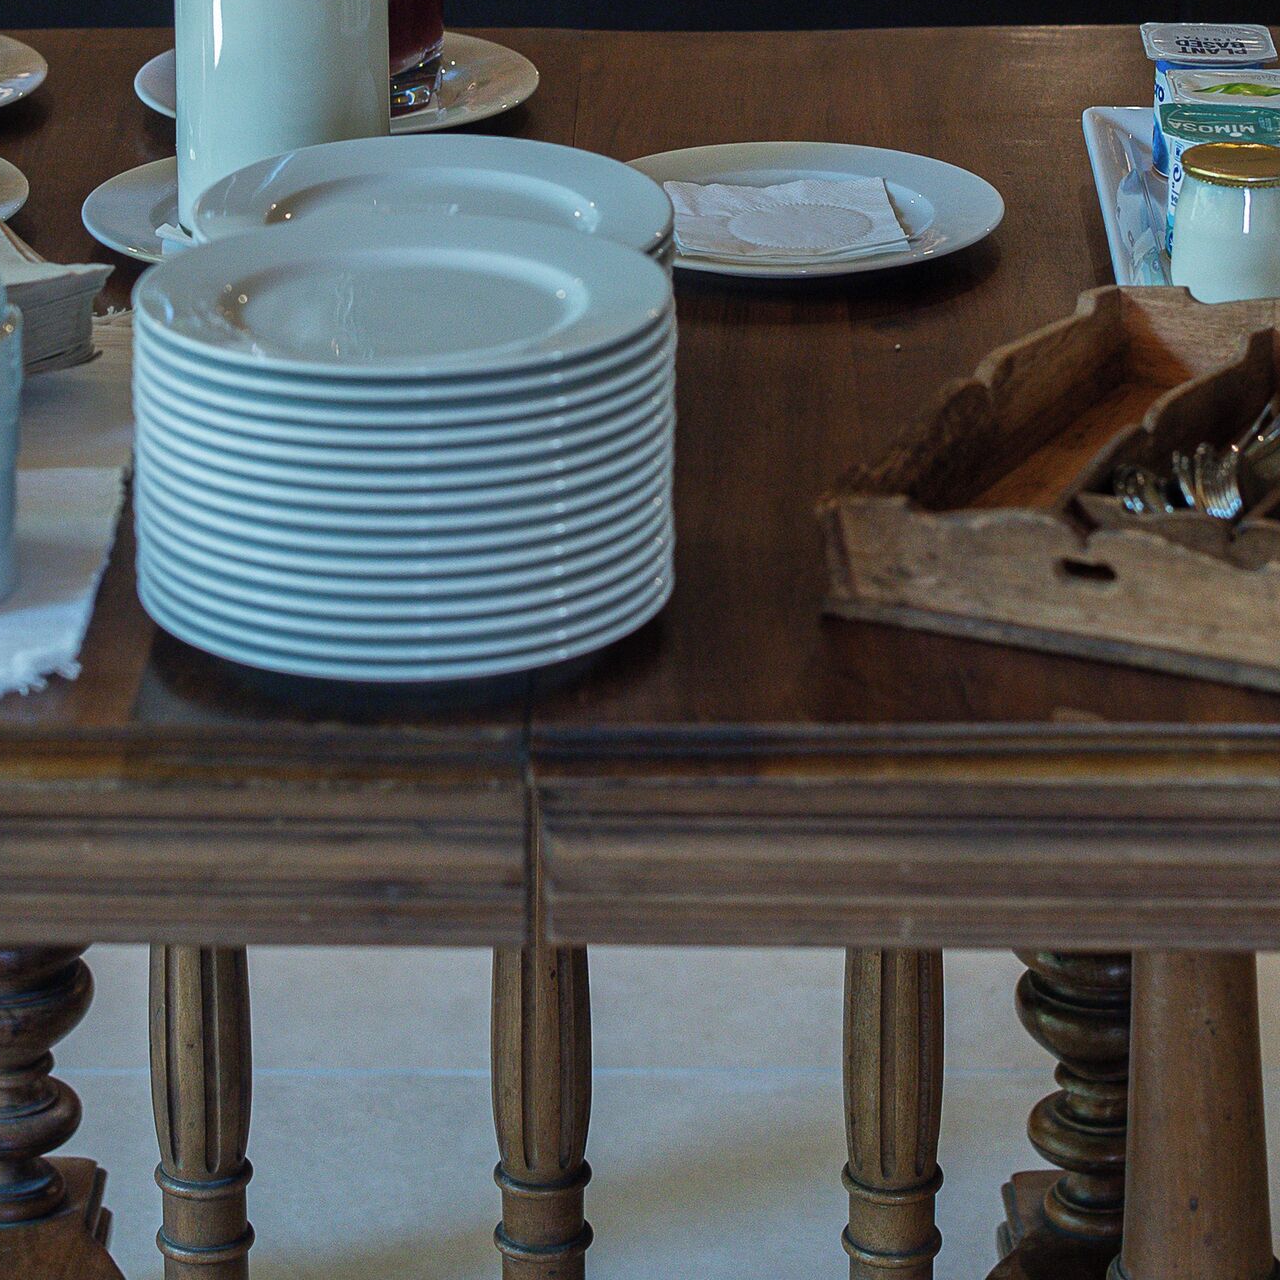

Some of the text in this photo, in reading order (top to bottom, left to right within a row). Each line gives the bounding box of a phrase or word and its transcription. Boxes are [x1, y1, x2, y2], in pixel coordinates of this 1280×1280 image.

[1175, 39, 1246, 48] BASED
[1178, 46, 1248, 56] PLANT
[1167, 120, 1256, 138] MIMOSA
